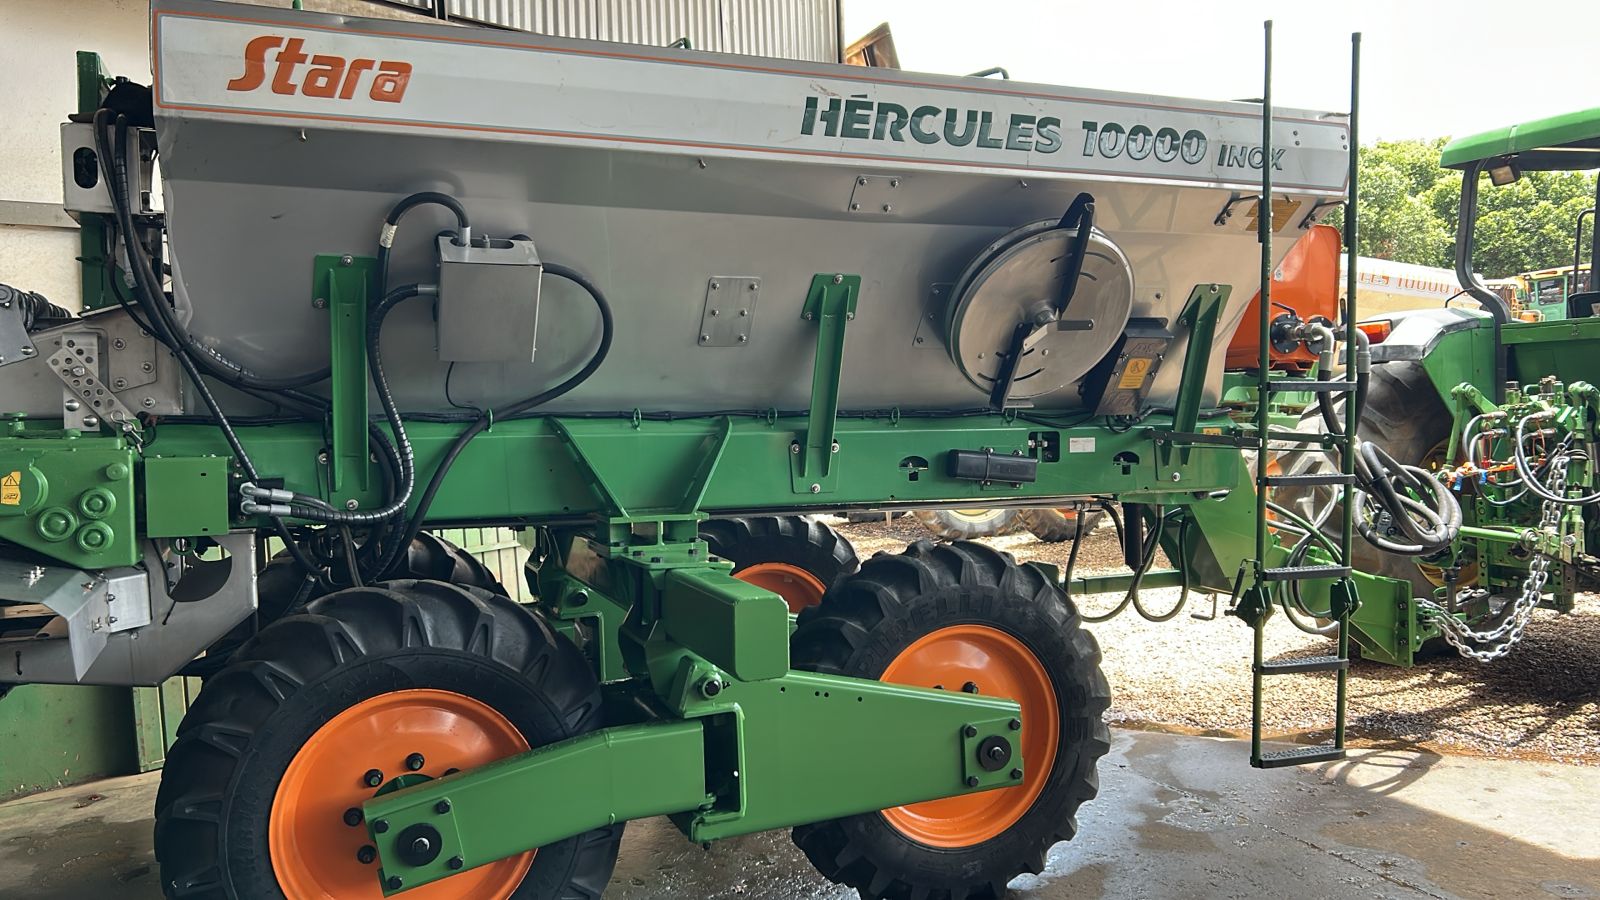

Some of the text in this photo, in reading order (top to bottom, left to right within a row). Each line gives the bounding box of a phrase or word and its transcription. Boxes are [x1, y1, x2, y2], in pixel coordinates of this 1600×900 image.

[227, 35, 413, 104] Stara
[801, 93, 1287, 171] HÉRCULES 10000 INOX
[856, 592, 993, 673] PIRELLI
